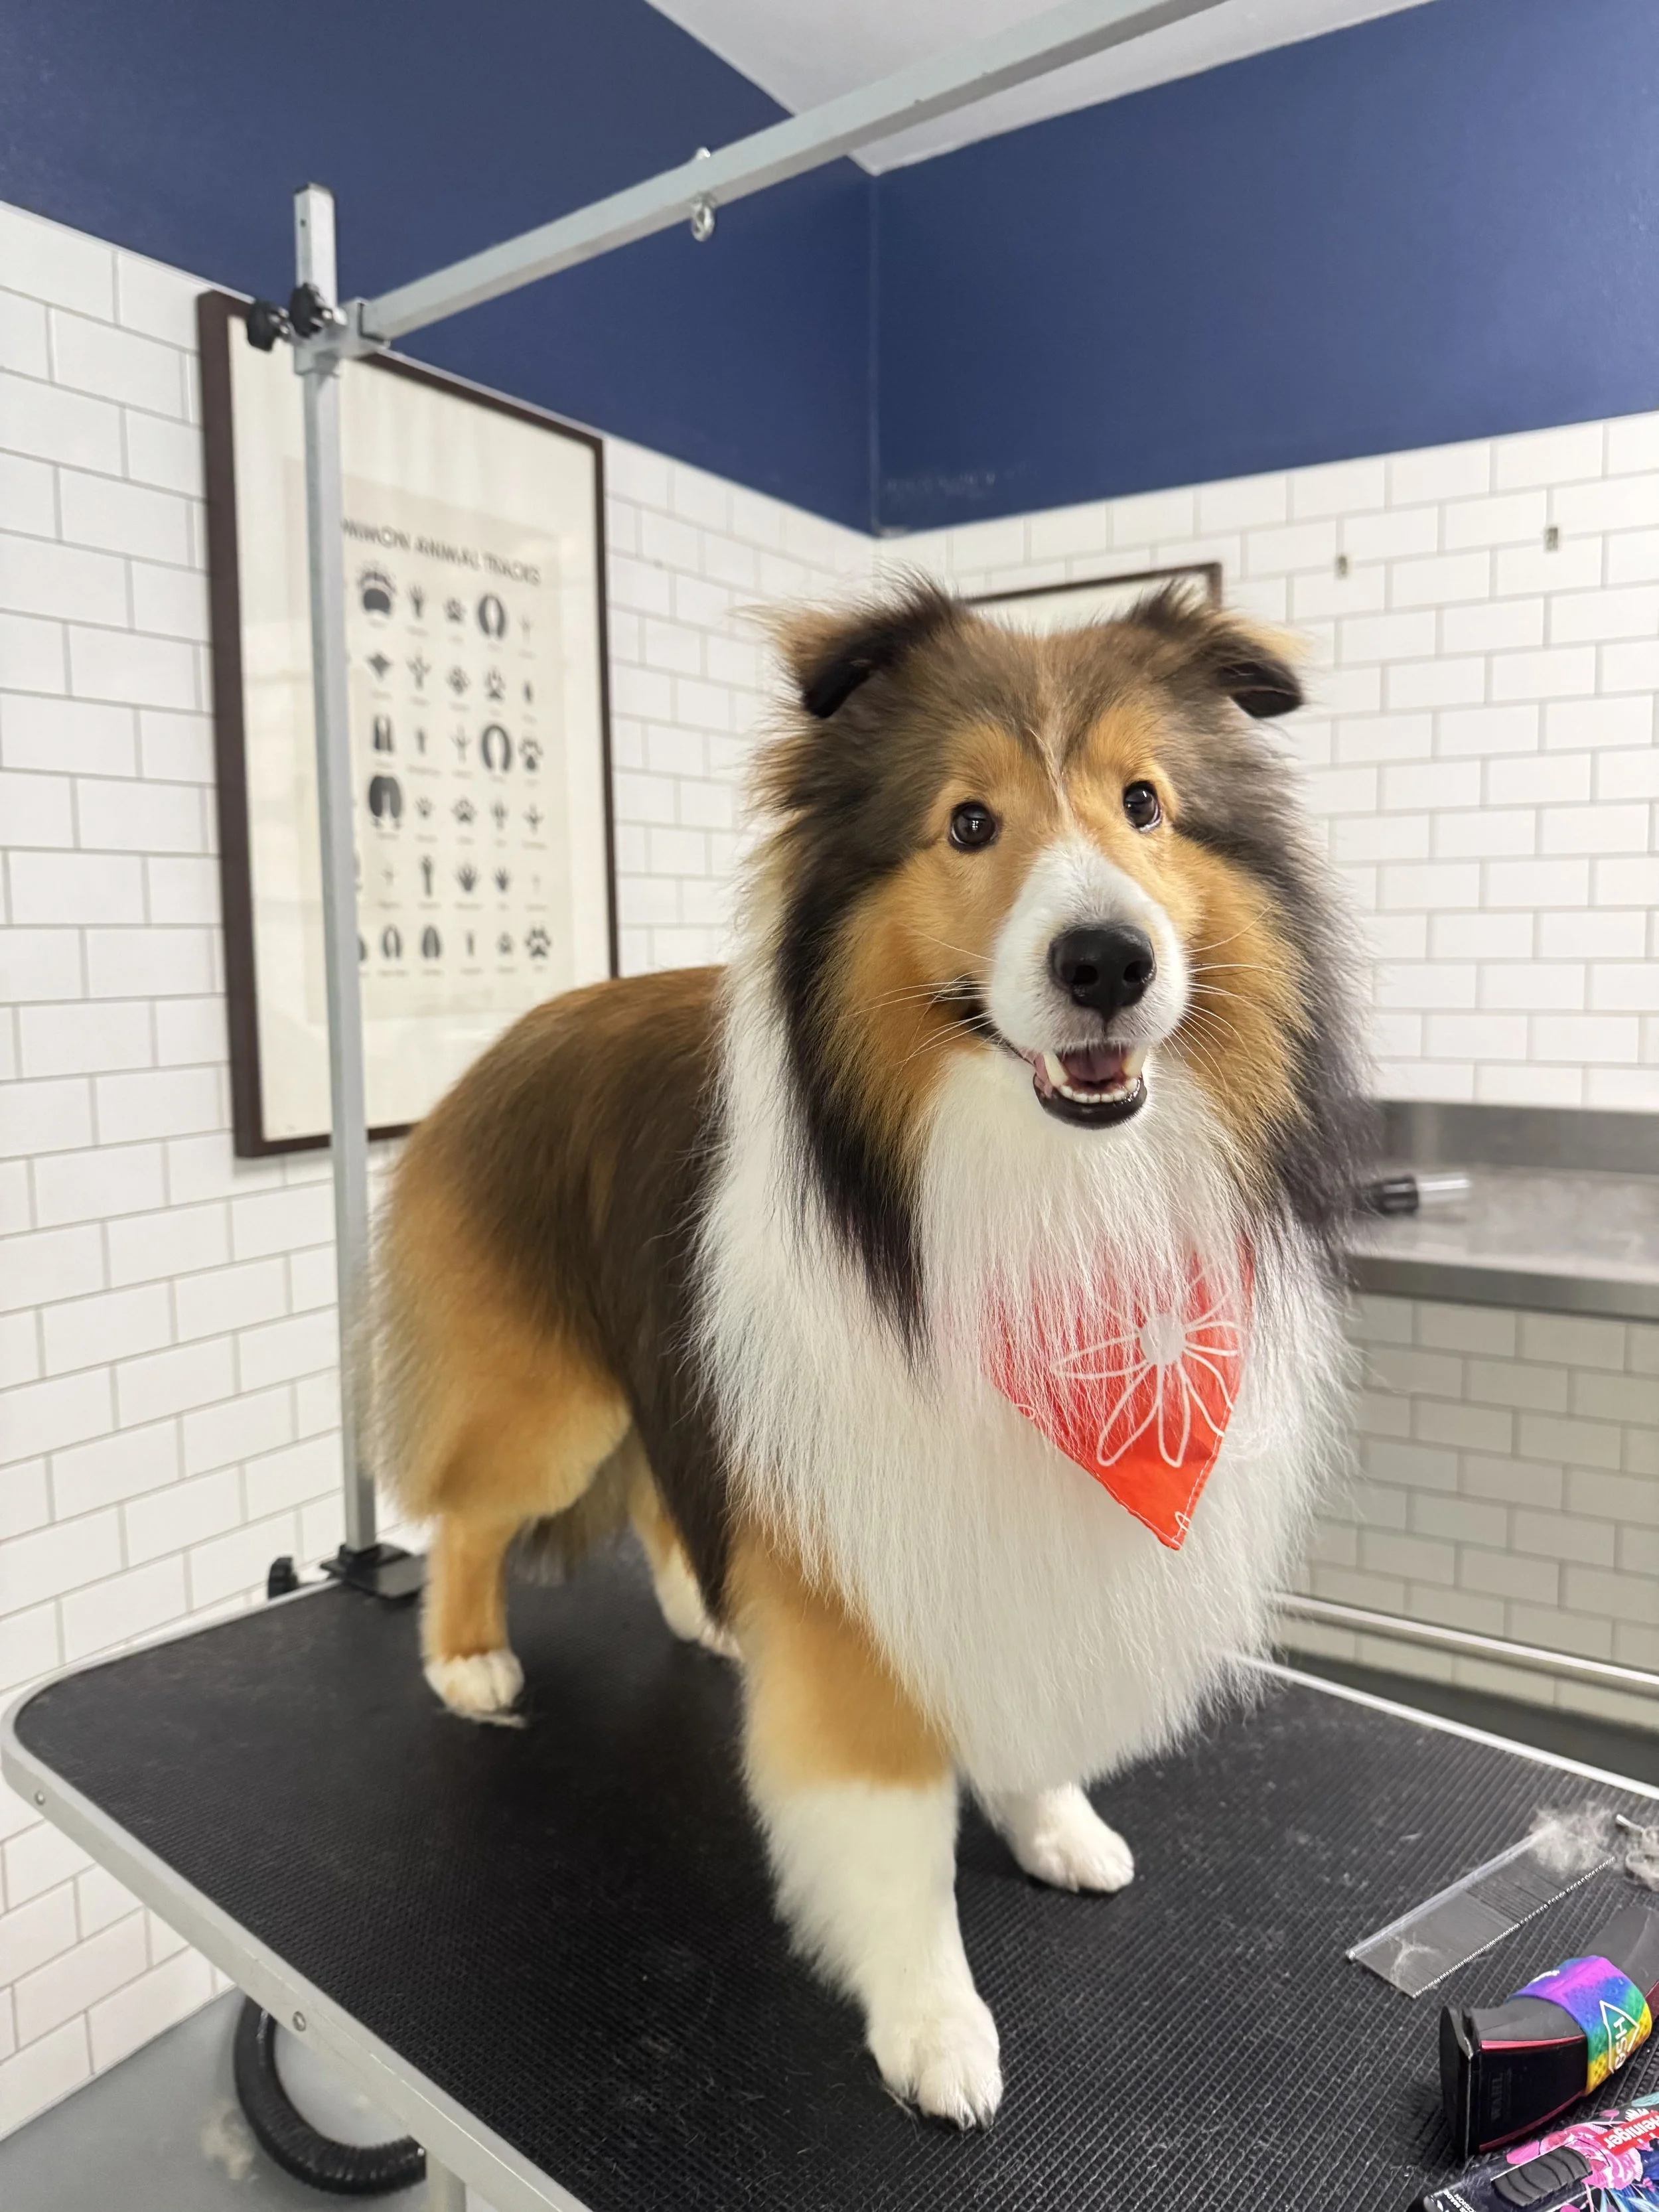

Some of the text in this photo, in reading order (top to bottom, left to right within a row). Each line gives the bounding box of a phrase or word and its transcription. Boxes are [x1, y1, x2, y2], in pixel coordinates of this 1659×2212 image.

[341, 518, 541, 585] MMON ANIMAL TRACKS
[1491, 2072, 1503, 2123] WAHL
[1443, 2188, 1461, 2208] MADE
[1454, 2193, 1477, 2212] CISION
